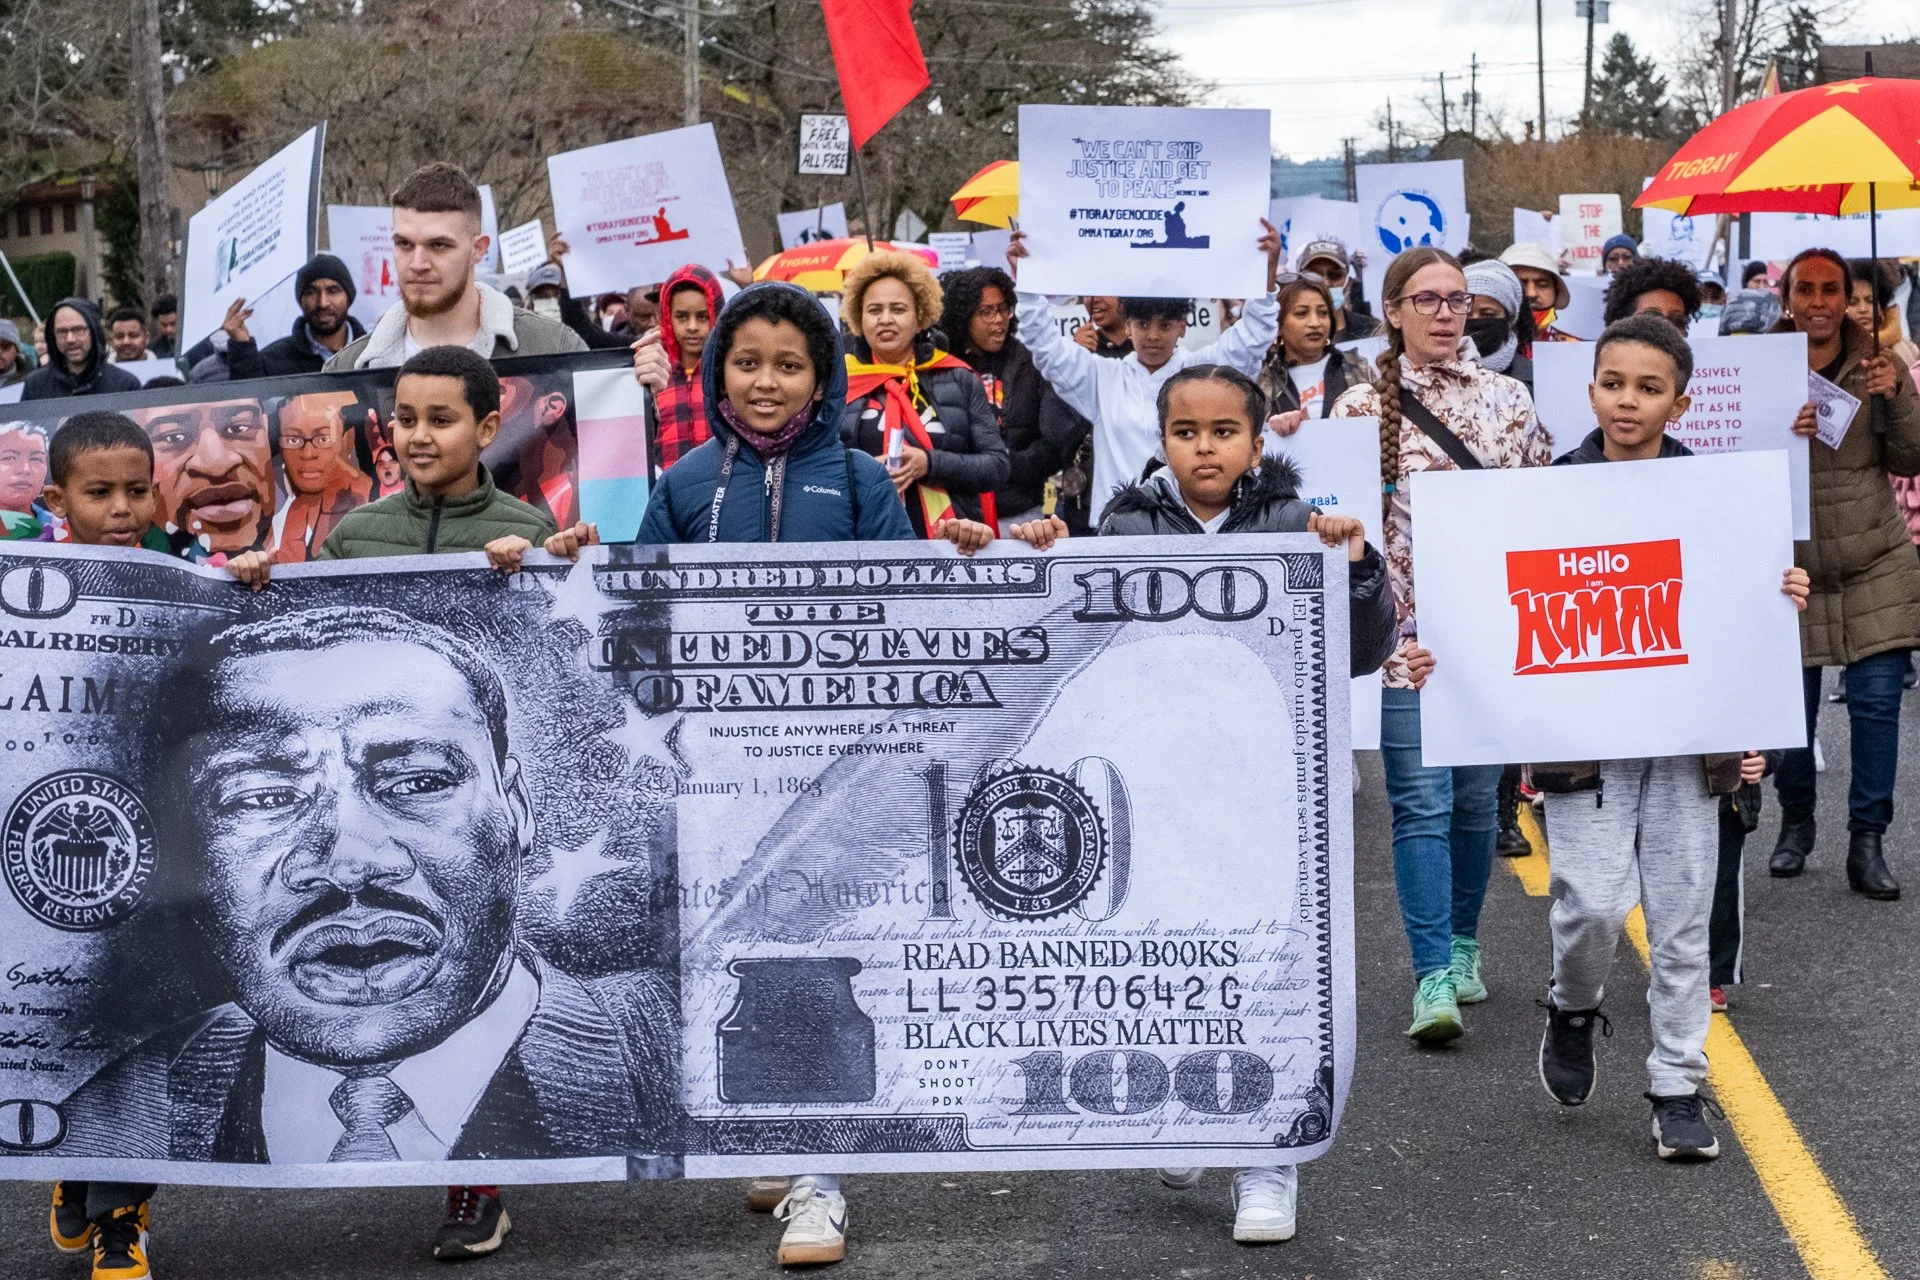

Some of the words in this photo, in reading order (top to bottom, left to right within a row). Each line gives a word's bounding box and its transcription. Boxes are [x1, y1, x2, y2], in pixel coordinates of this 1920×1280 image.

[808, 127, 840, 141] FREE
[801, 153, 820, 168] ALL
[821, 152, 848, 169] FREE
[1112, 139, 1163, 159] CAN'T
[1166, 141, 1203, 160] SKIP
[1066, 159, 1136, 178] JUSTICE
[1139, 160, 1174, 179] AND
[1177, 160, 1211, 180] GET
[1665, 152, 1739, 181] TIGRAY
[1095, 179, 1120, 198] TO
[1069, 208, 1164, 221] #TIGRAYGENOCIDE
[1579, 204, 1603, 218] STOP
[1583, 225, 1602, 239] THE
[778, 254, 830, 269] TIGRAY
[1688, 387, 1703, 396] AS
[1707, 385, 1741, 395] MUCH
[1694, 403, 1705, 413] IT
[1709, 402, 1724, 413] AS
[1727, 402, 1742, 412] HE
[1664, 421, 1682, 431] HO
[1686, 420, 1721, 431] HELPS
[1725, 419, 1742, 429] TO
[1679, 436, 1723, 448] ETRATE
[810, 485, 842, 497] Columbia
[711, 487, 726, 525] MATTER
[1558, 550, 1630, 577] Hello
[601, 567, 818, 590] HUNDRED
[820, 562, 1038, 588] DOLLARS
[1591, 579, 1604, 587] am
[1073, 566, 1268, 623] 100
[90, 614, 111, 626] FW
[116, 607, 137, 628] D
[746, 602, 886, 626] THE
[1509, 578, 1684, 672] HUMAN
[1267, 616, 1285, 637] D
[588, 631, 814, 672] UNITED
[816, 626, 1050, 668] STATES
[1290, 628, 1308, 689] pueblo
[634, 674, 721, 716] OF
[715, 670, 1003, 712] AMERICA
[709, 725, 779, 738] INJUSTICE
[784, 723, 865, 737] ANYWHERE
[870, 722, 883, 735] IS
[887, 722, 898, 734] A
[903, 721, 957, 734] THREAT
[1295, 693, 1310, 747] unido
[744, 746, 763, 757] TO
[768, 744, 823, 757] JUSTICE
[829, 742, 924, 756] EVERYWHERE
[674, 778, 744, 799] January
[752, 778, 768, 797] 1,
[776, 776, 822, 798] 1863
[22, 778, 84, 815] UNITED
[90, 779, 143, 821] STATES
[1029, 777, 1050, 791] OF
[1077, 814, 1097, 887] TREASURY
[8, 829, 39, 904] FEDERAL
[41, 900, 117, 923] RESERVE
[119, 837, 153, 905] SYSTEM
[1298, 850, 1314, 924] vencido!
[884, 922, 924, 941] bands
[931, 919, 978, 939] which
[979, 920, 1011, 938] have
[1016, 920, 1080, 938] connected
[1083, 917, 1122, 937] them
[1124, 918, 1160, 937] with
[1229, 918, 1262, 936] and
[903, 942, 990, 970] READ
[999, 940, 1132, 969] BANNED
[1141, 940, 1238, 967] BOOKS
[1266, 943, 1303, 973] they
[858, 986, 892, 997] men
[907, 976, 960, 1012] LL
[976, 974, 1205, 1011] 35570642
[1242, 1001, 1275, 1018] their
[1272, 1002, 1312, 1028] just
[904, 1020, 1010, 1049] BLACK
[1016, 1019, 1108, 1048] LIVES
[1115, 1018, 1247, 1046] MATTER
[0, 1057, 26, 1071] nited
[924, 1059, 970, 1070] DONT
[919, 1077, 976, 1089] SHOOT
[1009, 1050, 1274, 1117] 100
[931, 1096, 964, 1106] PDX
[1014, 1114, 1084, 1141] pursuing
[1172, 1109, 1197, 1127] the
[1197, 1115, 1241, 1127] same
